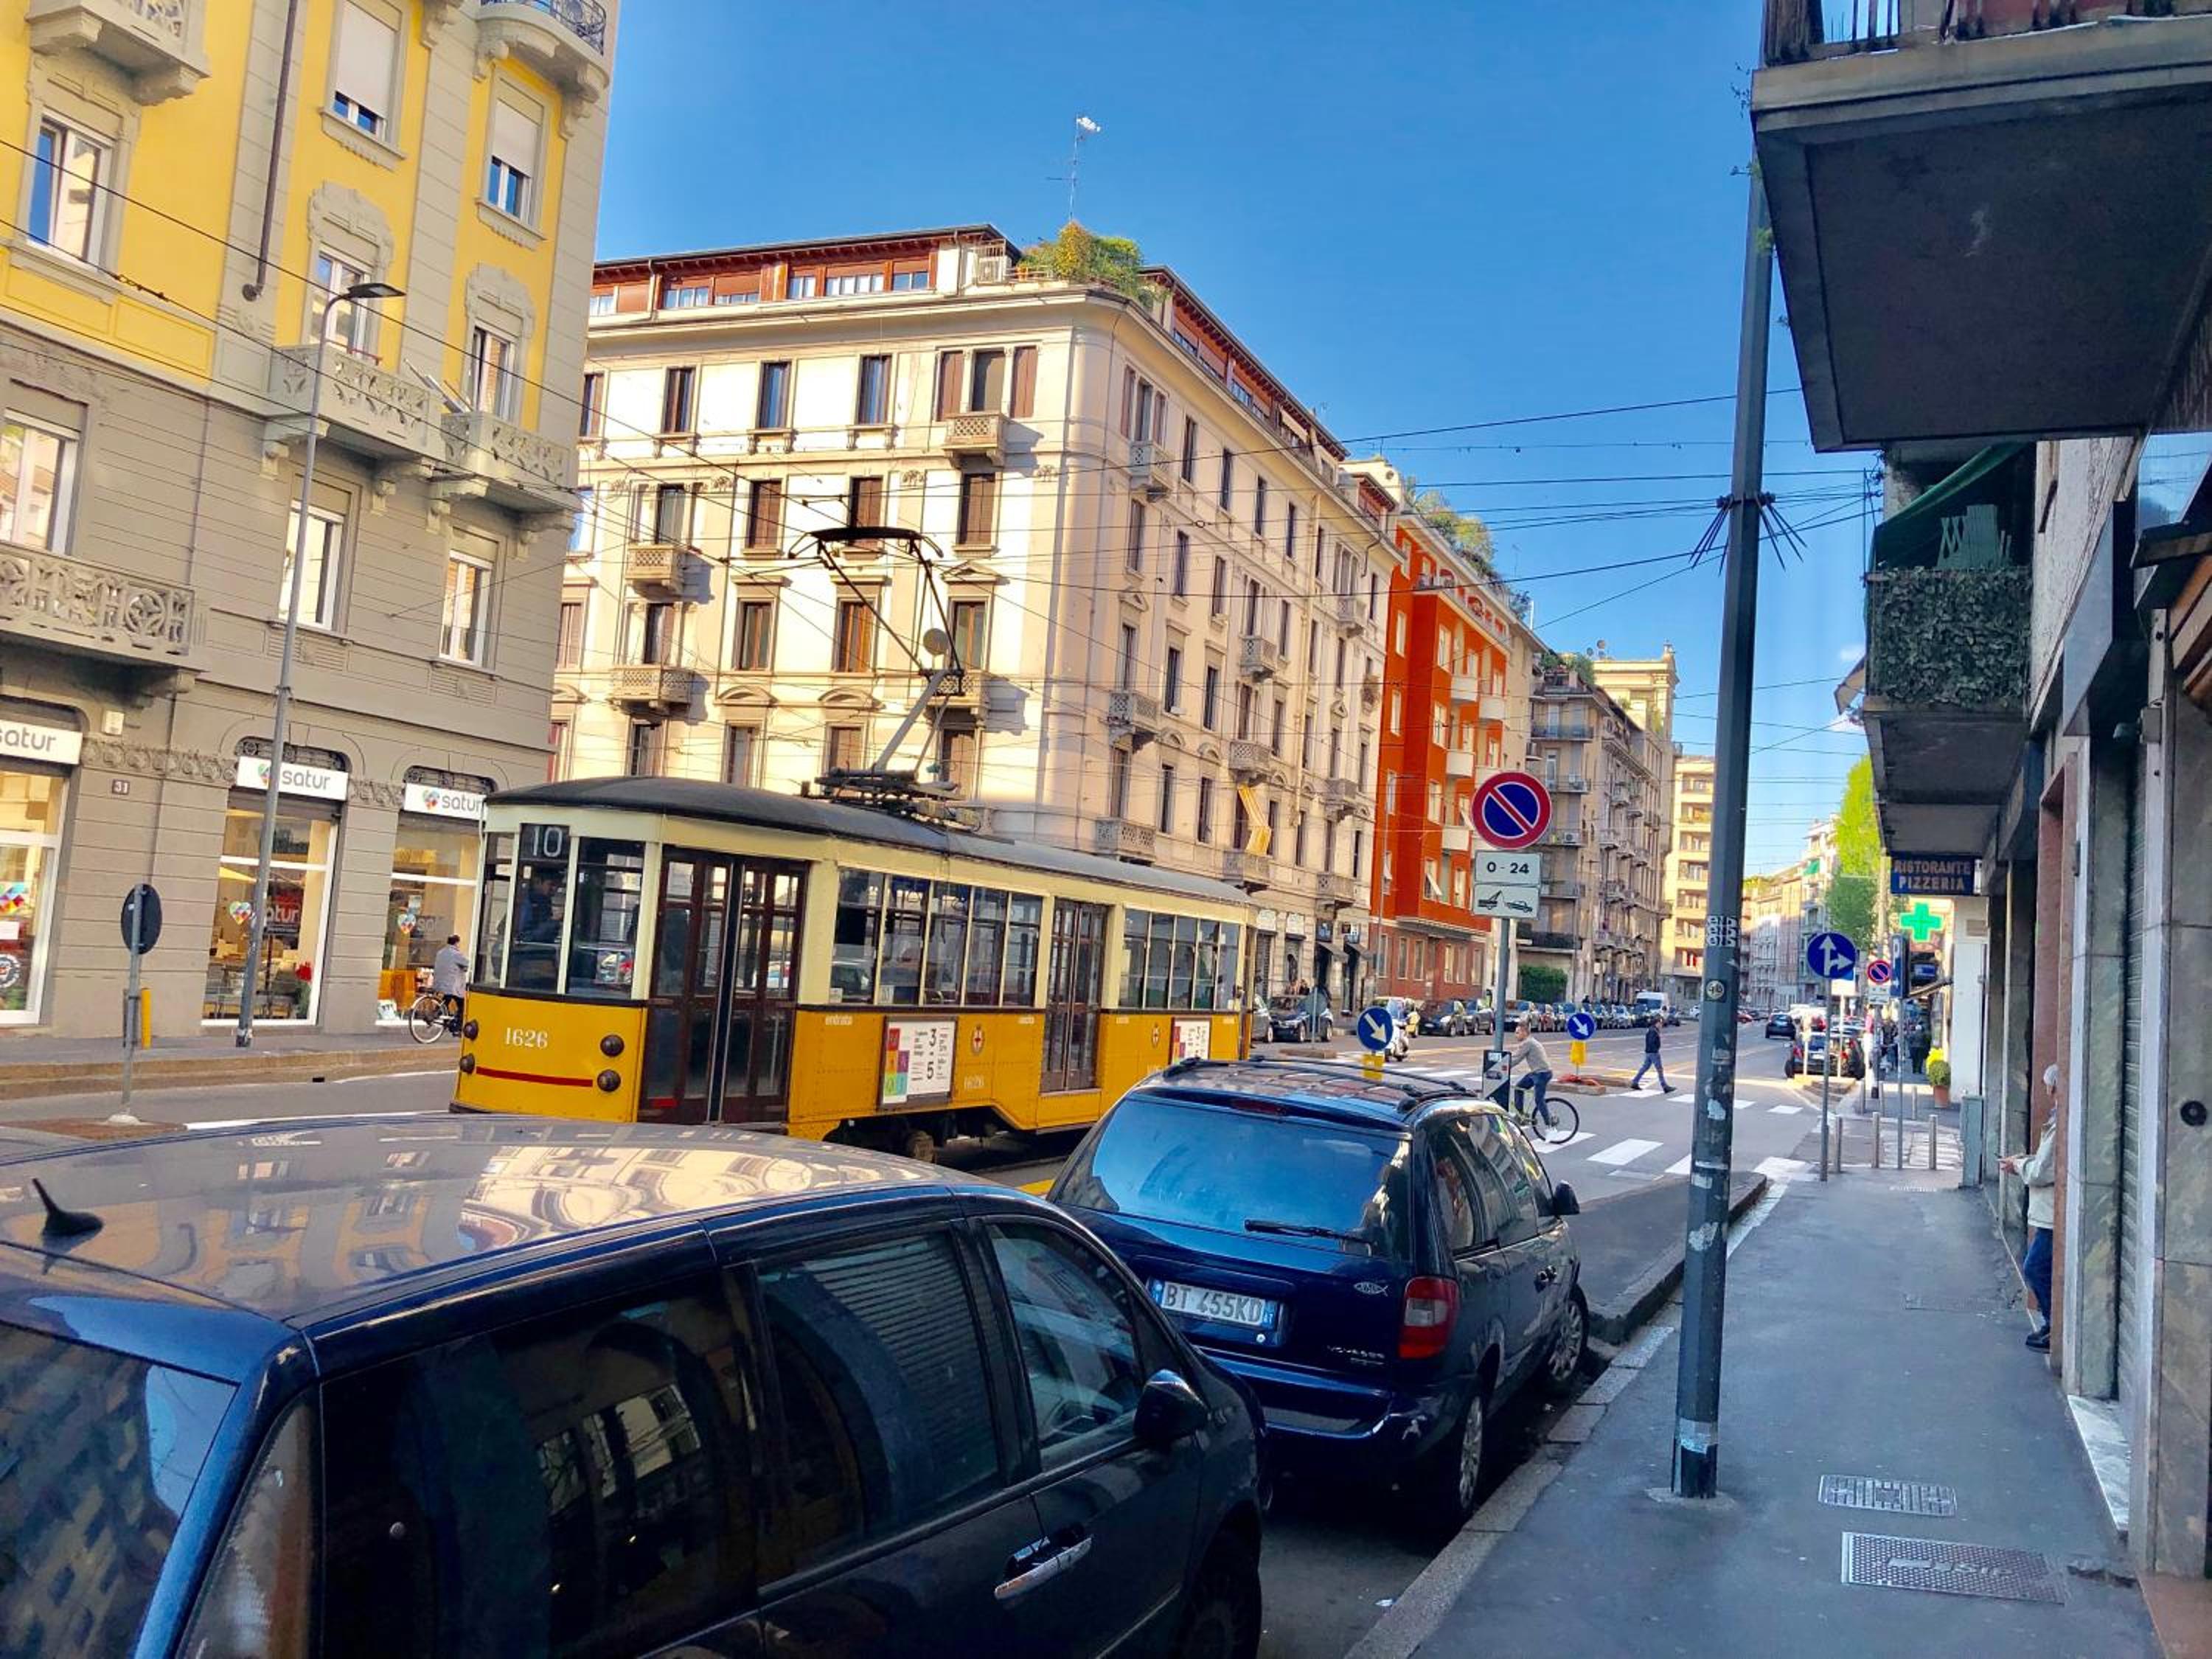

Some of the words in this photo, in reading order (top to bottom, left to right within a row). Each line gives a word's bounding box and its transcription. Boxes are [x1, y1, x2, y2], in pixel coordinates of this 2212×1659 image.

[0, 727, 56, 752] atur
[282, 769, 330, 790] satur
[532, 826, 563, 857] 10
[1509, 862, 1530, 874] 24
[1894, 860, 1972, 875] RISTORANTE
[1899, 875, 1966, 891] PIZZERIA
[506, 1027, 548, 1048] 1626
[929, 1028, 936, 1047] 3
[927, 1061, 934, 1080] 5
[1166, 1284, 1191, 1309] BT
